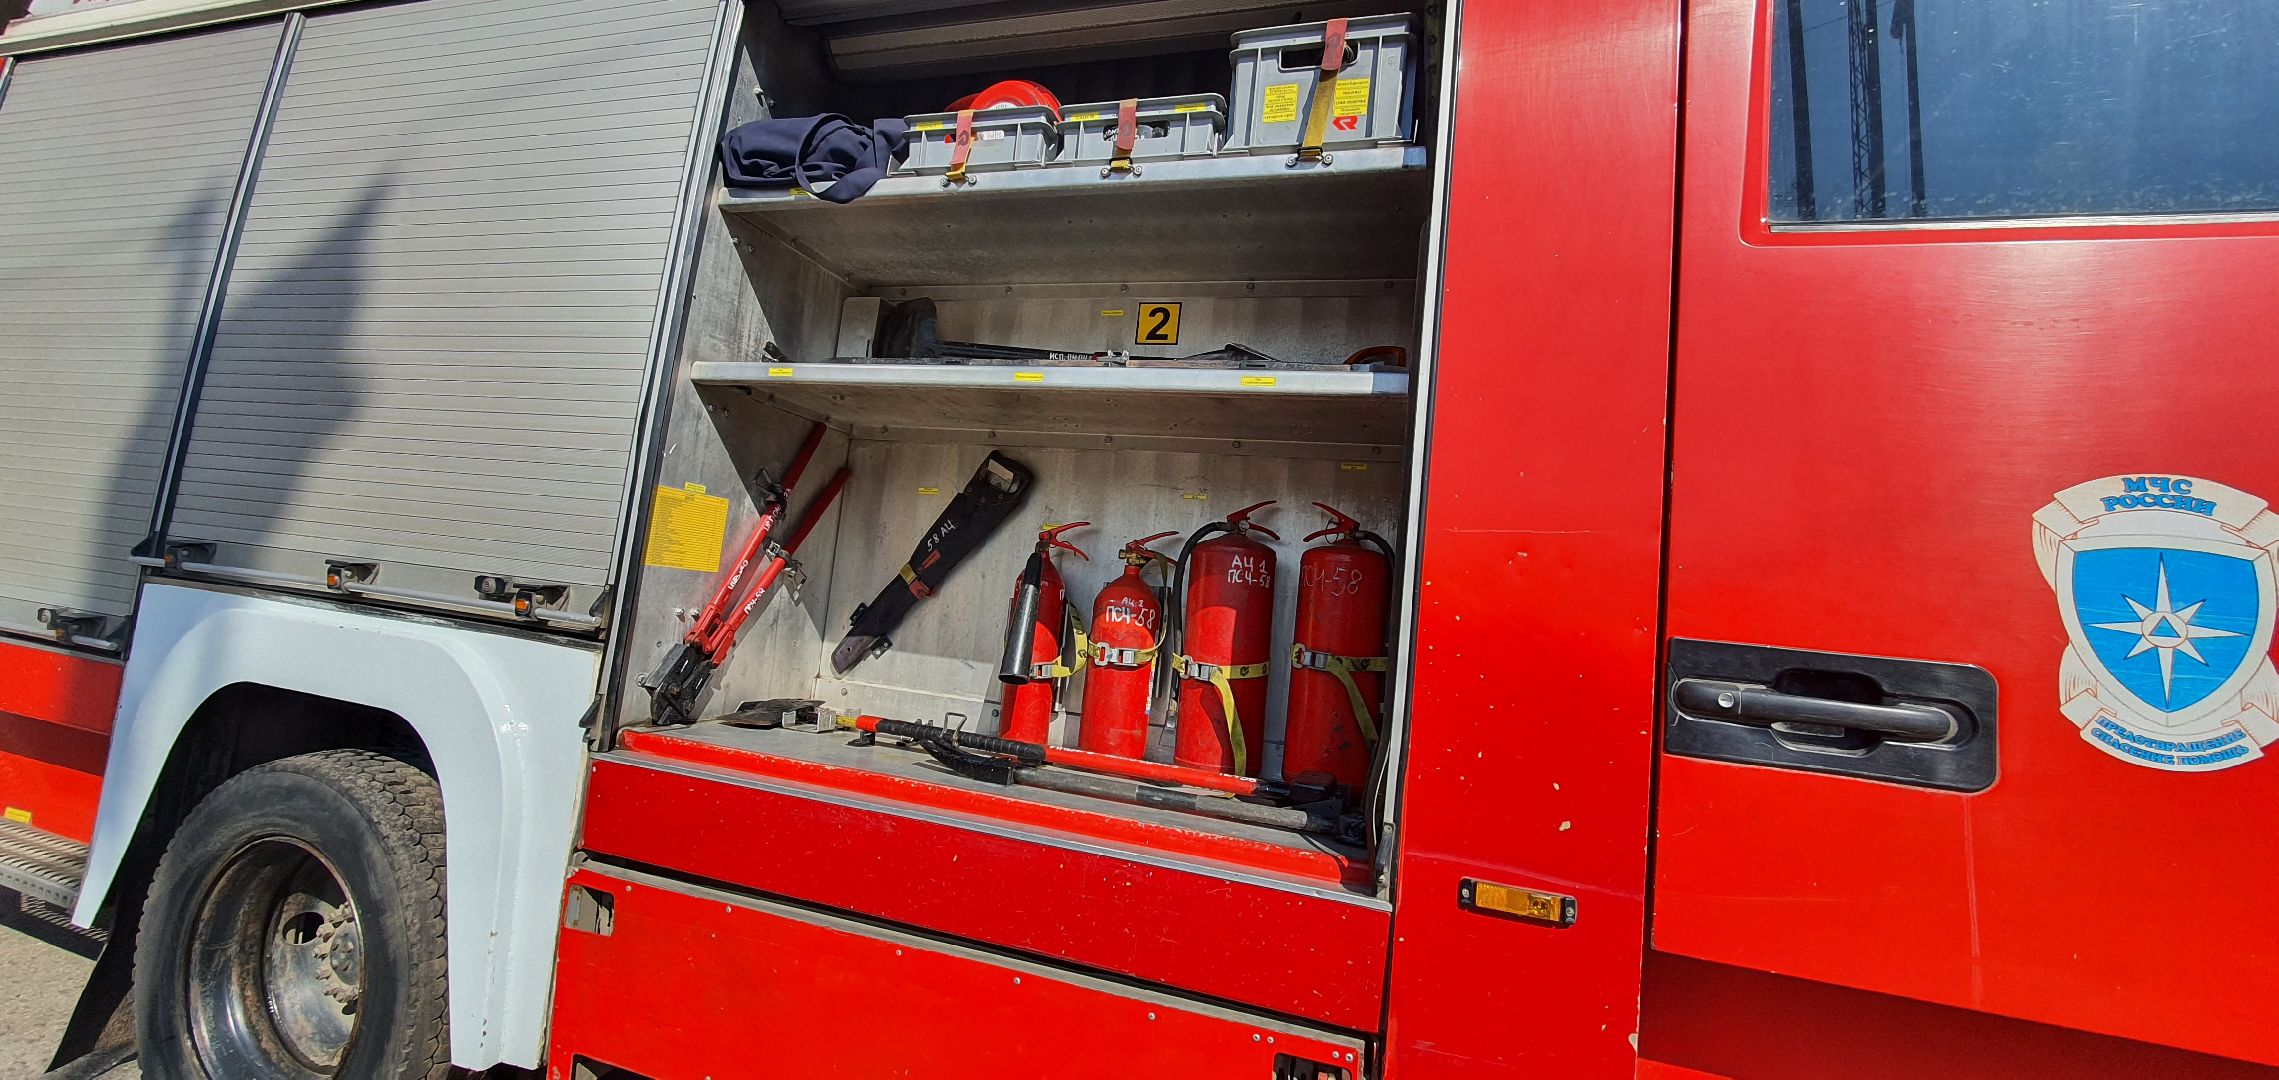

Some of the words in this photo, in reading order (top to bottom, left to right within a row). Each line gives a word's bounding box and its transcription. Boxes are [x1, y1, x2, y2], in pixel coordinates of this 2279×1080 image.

[1145, 307, 1171, 340] 2
[2121, 476, 2193, 494] МЧС
[2100, 493, 2217, 516] РОССИИ
[1228, 569, 1271, 589] ПСЧ-58
[1105, 606, 1156, 629] ПСЧ-58
[2095, 716, 2247, 752] ПРЕДОТВРАЩЕНИЕ
[2091, 727, 2175, 765] СПАСЕНИЕ
[2177, 745, 2249, 765] ПОМОЩЬ
